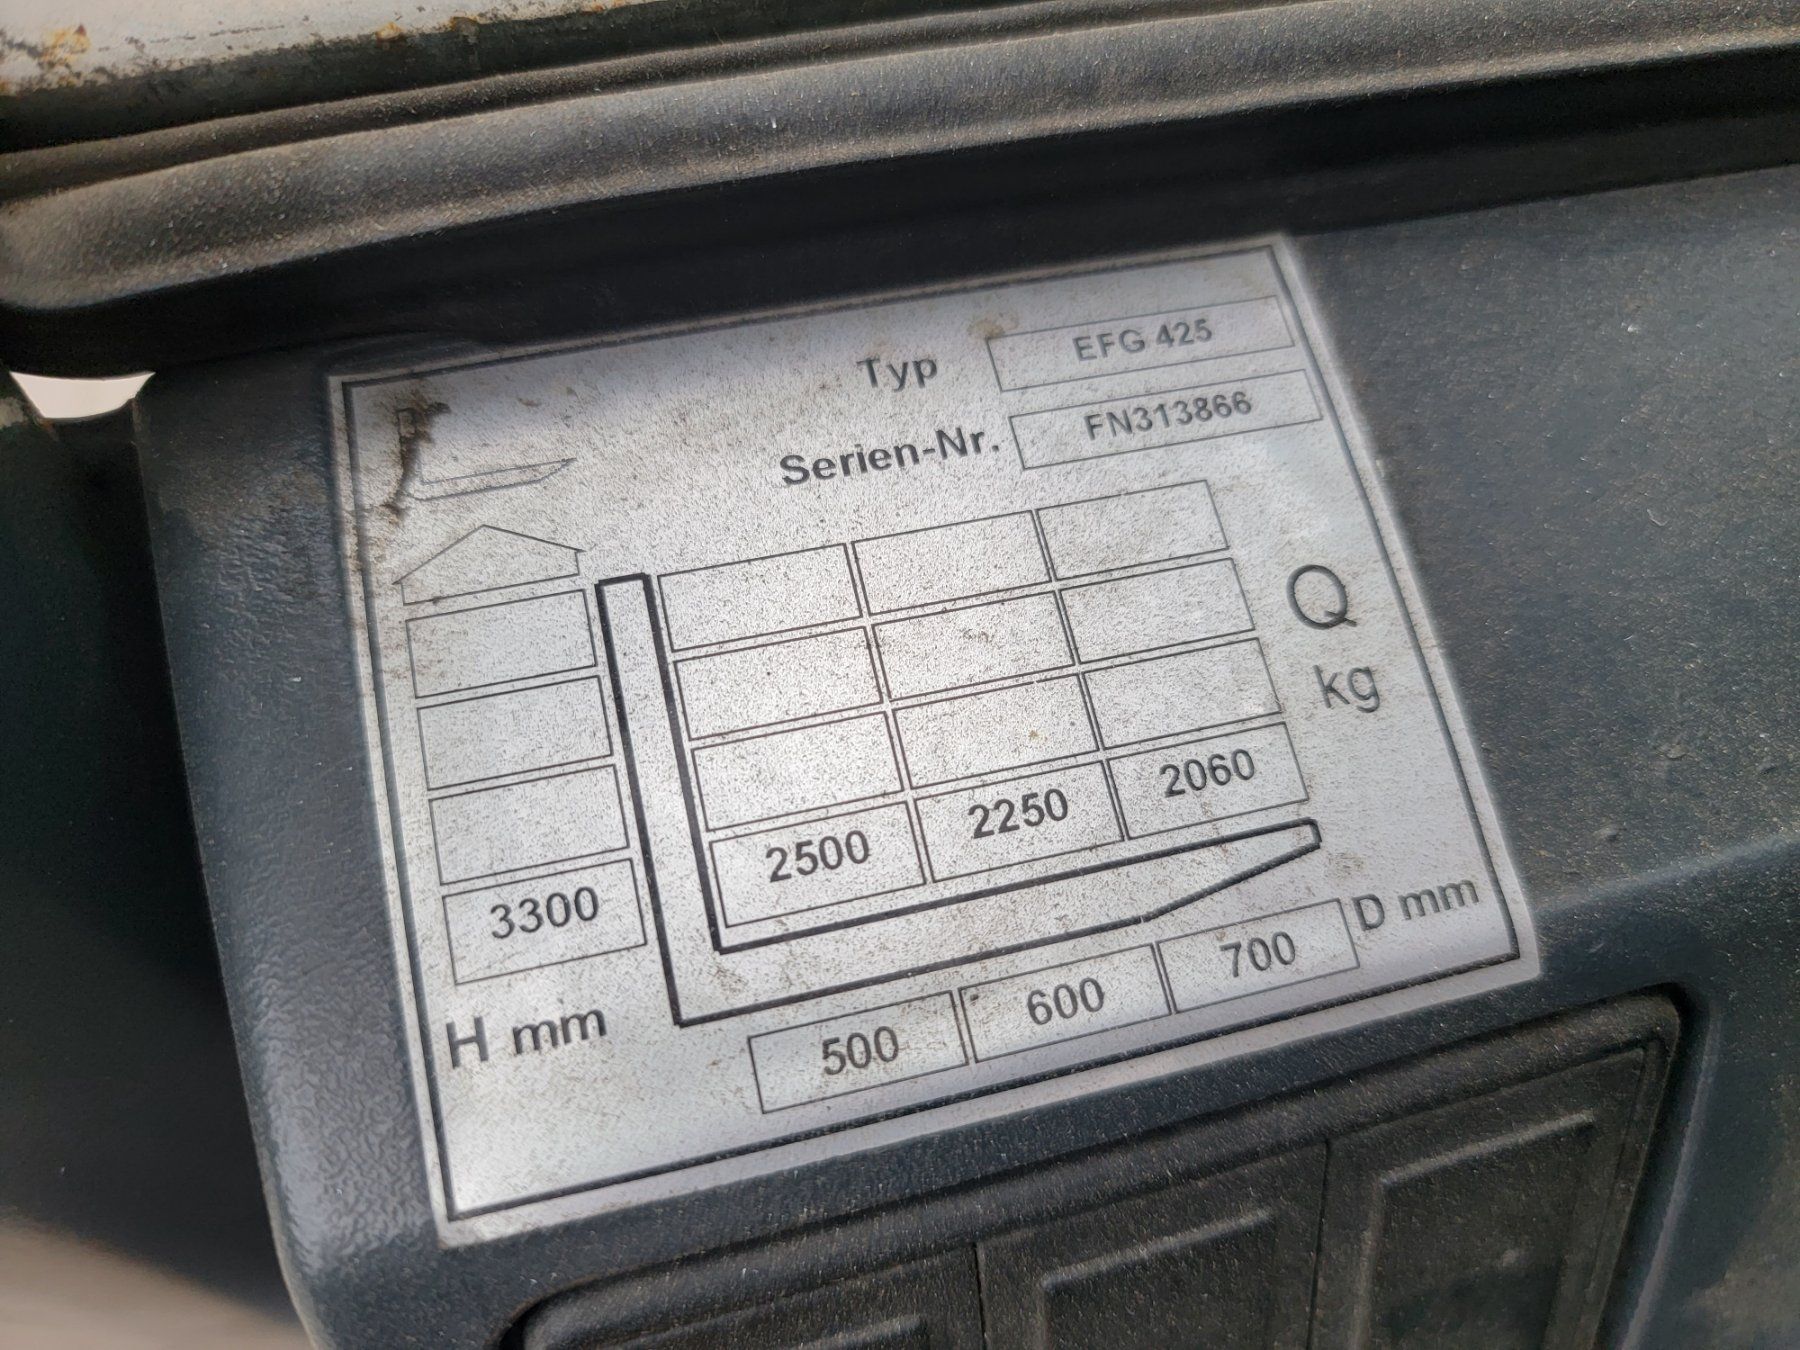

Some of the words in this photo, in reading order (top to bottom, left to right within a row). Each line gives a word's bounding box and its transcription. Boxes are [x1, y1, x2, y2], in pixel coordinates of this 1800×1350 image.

[857, 353, 939, 393] Typ
[1072, 325, 1147, 362] EFG
[1156, 317, 1213, 349] 425
[779, 424, 1000, 486] Serien-Nr.
[1083, 390, 1253, 441] FN313866
[1285, 564, 1358, 630] Q
[1313, 664, 1381, 713] kg
[765, 830, 871, 883] 2500
[967, 788, 1070, 839] 2250
[1159, 748, 1256, 798] 2060
[490, 886, 599, 939] 3300
[821, 1025, 900, 1076] 500
[1025, 976, 1105, 1026] 600
[1219, 930, 1297, 979] 700
[1352, 893, 1386, 932] D
[1399, 878, 1480, 921] mm
[446, 1015, 490, 1070] H
[512, 1008, 608, 1056] mm
